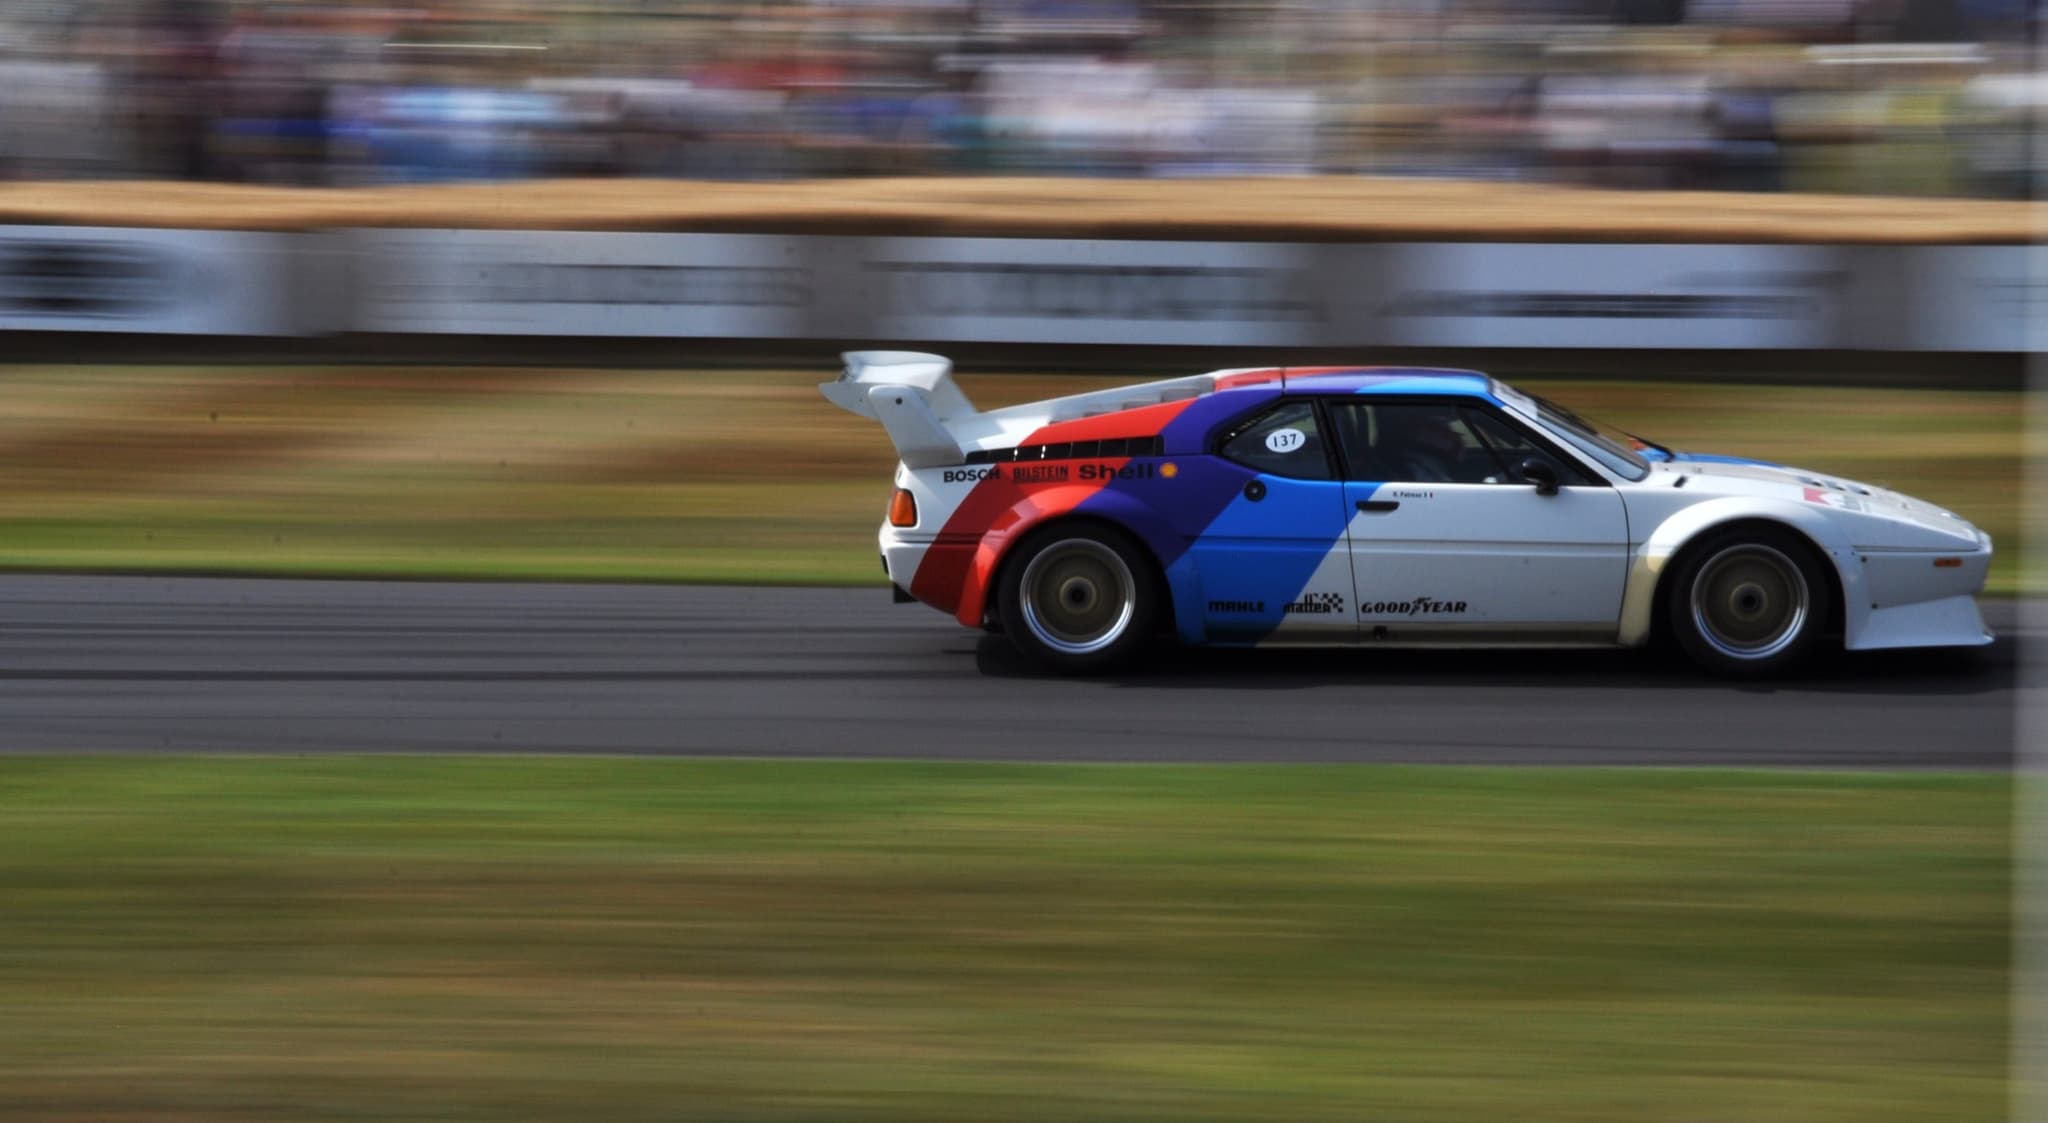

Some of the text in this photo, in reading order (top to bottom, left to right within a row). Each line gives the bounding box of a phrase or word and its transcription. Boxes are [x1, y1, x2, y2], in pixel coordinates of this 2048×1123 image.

[1274, 433, 1297, 448] 137
[943, 463, 1153, 483] BOSCH BILSTEIN Shell
[1361, 599, 1467, 614] GOODYEAR
